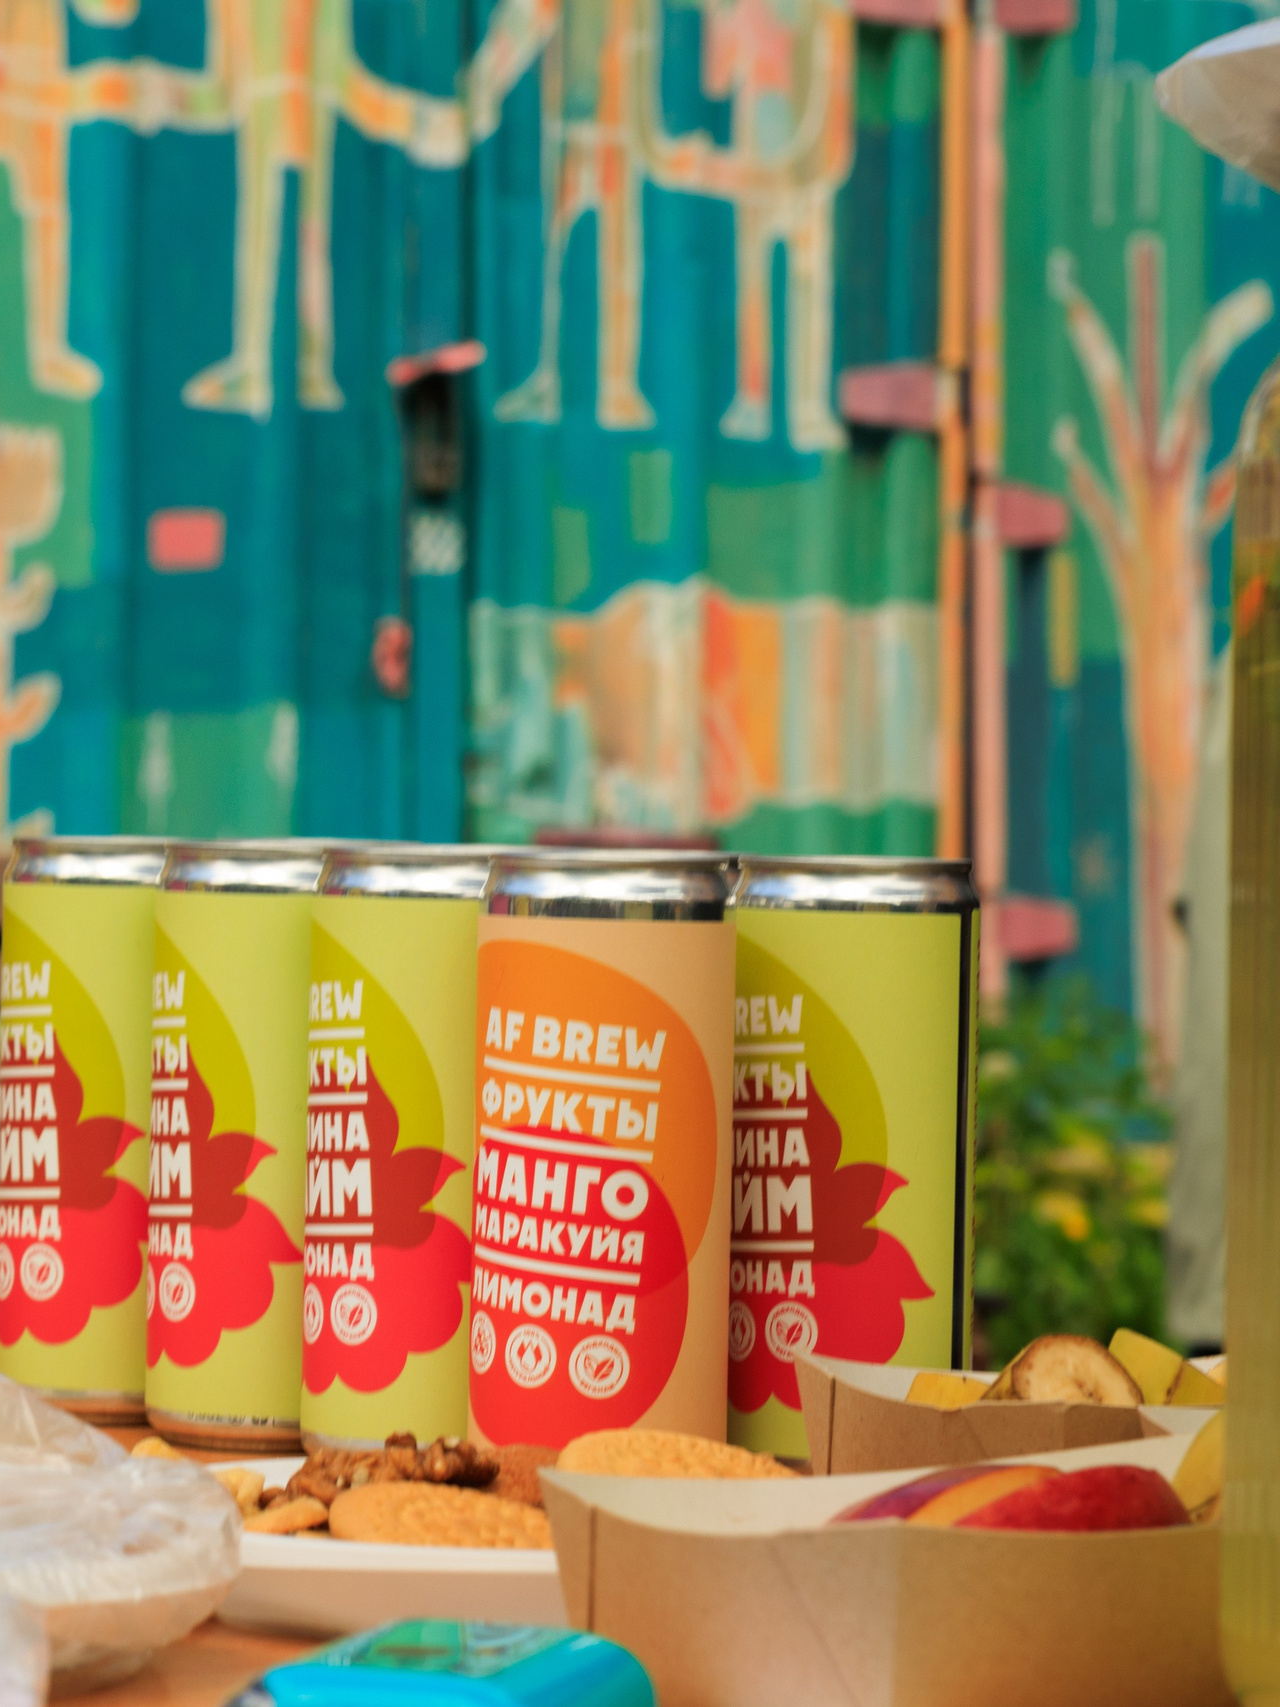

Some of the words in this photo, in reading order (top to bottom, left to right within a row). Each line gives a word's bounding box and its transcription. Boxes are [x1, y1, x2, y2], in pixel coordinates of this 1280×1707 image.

[153, 970, 185, 1010] EW
[735, 994, 803, 1035] REW
[485, 1006, 525, 1052] AF
[531, 1014, 667, 1071] BREW
[0, 1083, 57, 1121] ИНА
[307, 1111, 370, 1152] ИНА
[482, 1077, 659, 1143] ФРУКТЫ
[733, 1127, 810, 1167] ИНА
[307, 1154, 372, 1217] ЙМ
[477, 1144, 649, 1222] МАНГО
[475, 1202, 645, 1265] МАРАКУЙЯ
[473, 1265, 636, 1335] ЛИМОНАД
